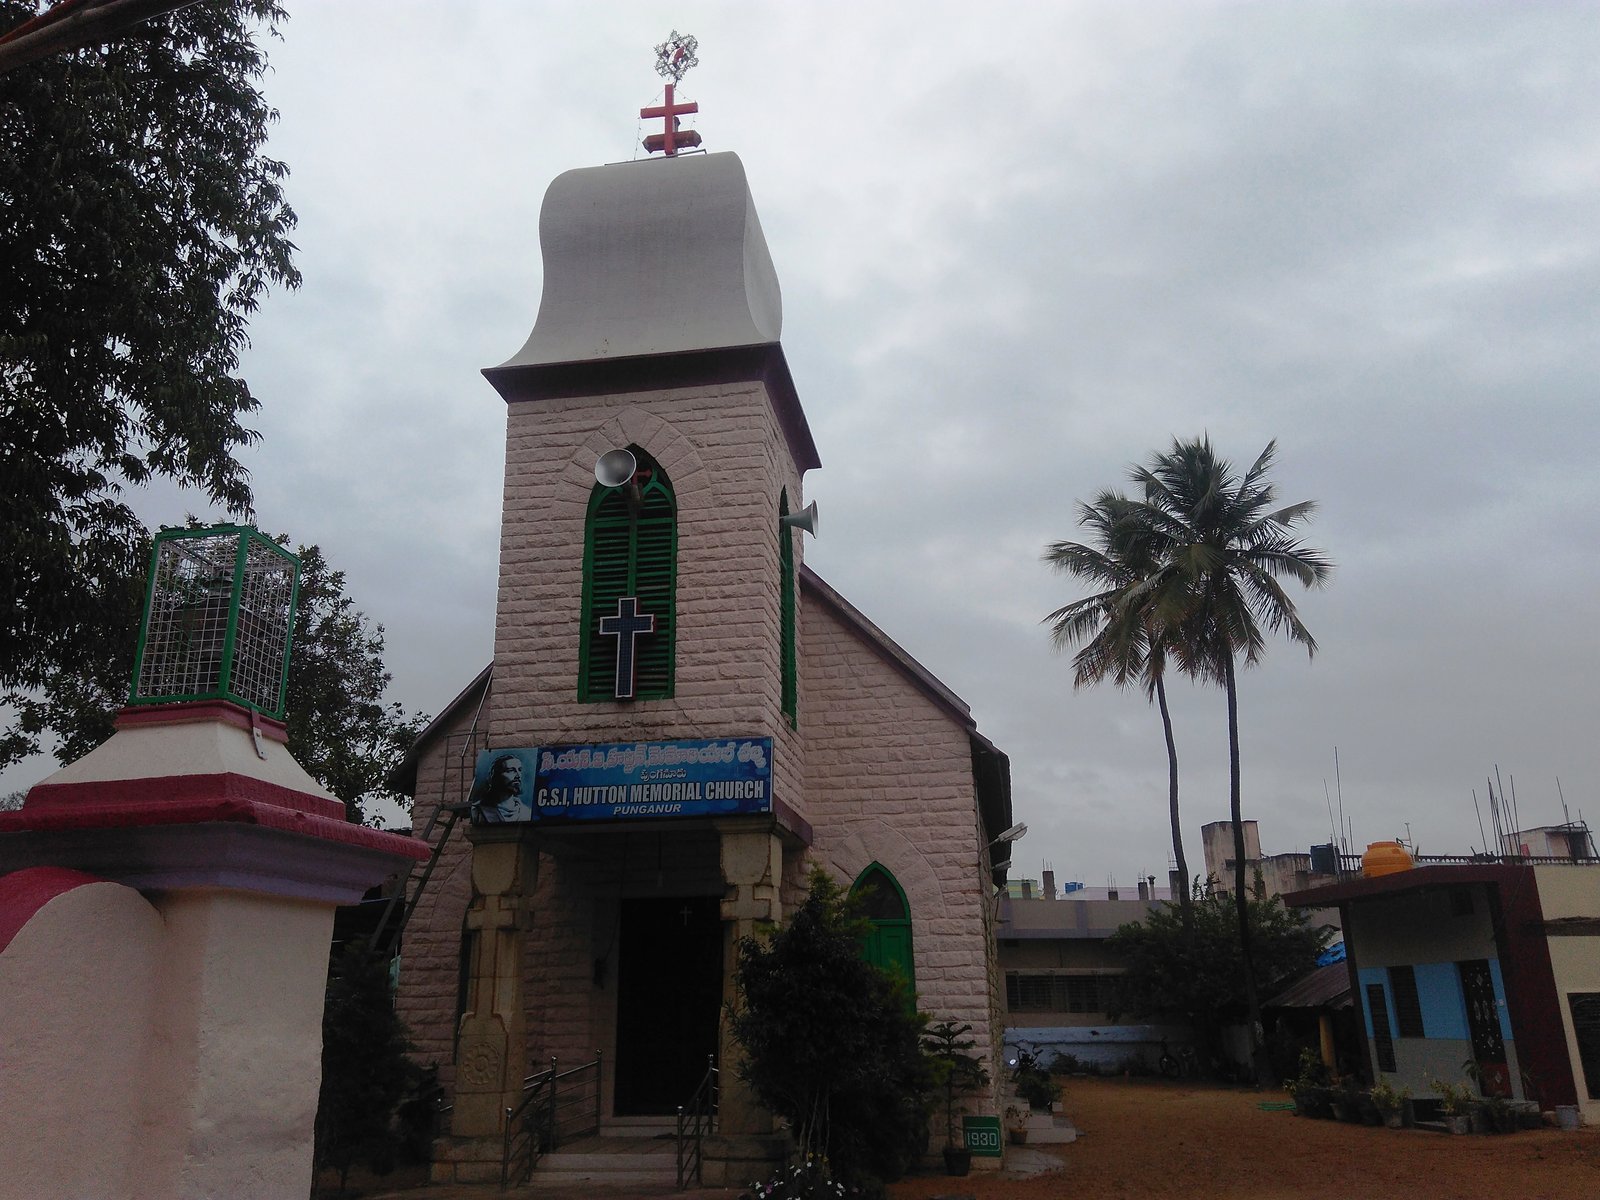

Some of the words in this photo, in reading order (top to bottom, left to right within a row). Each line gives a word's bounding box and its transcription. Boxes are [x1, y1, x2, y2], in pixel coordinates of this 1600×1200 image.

[737, 741, 767, 768] చర్చి
[640, 768, 687, 782] పుంగనూరు
[573, 785, 627, 805] HUTTON
[630, 782, 702, 802] MEMORIAL
[705, 780, 764, 800] CHURCH
[613, 803, 682, 815] PUNGANUR
[967, 1132, 998, 1146] 1930
